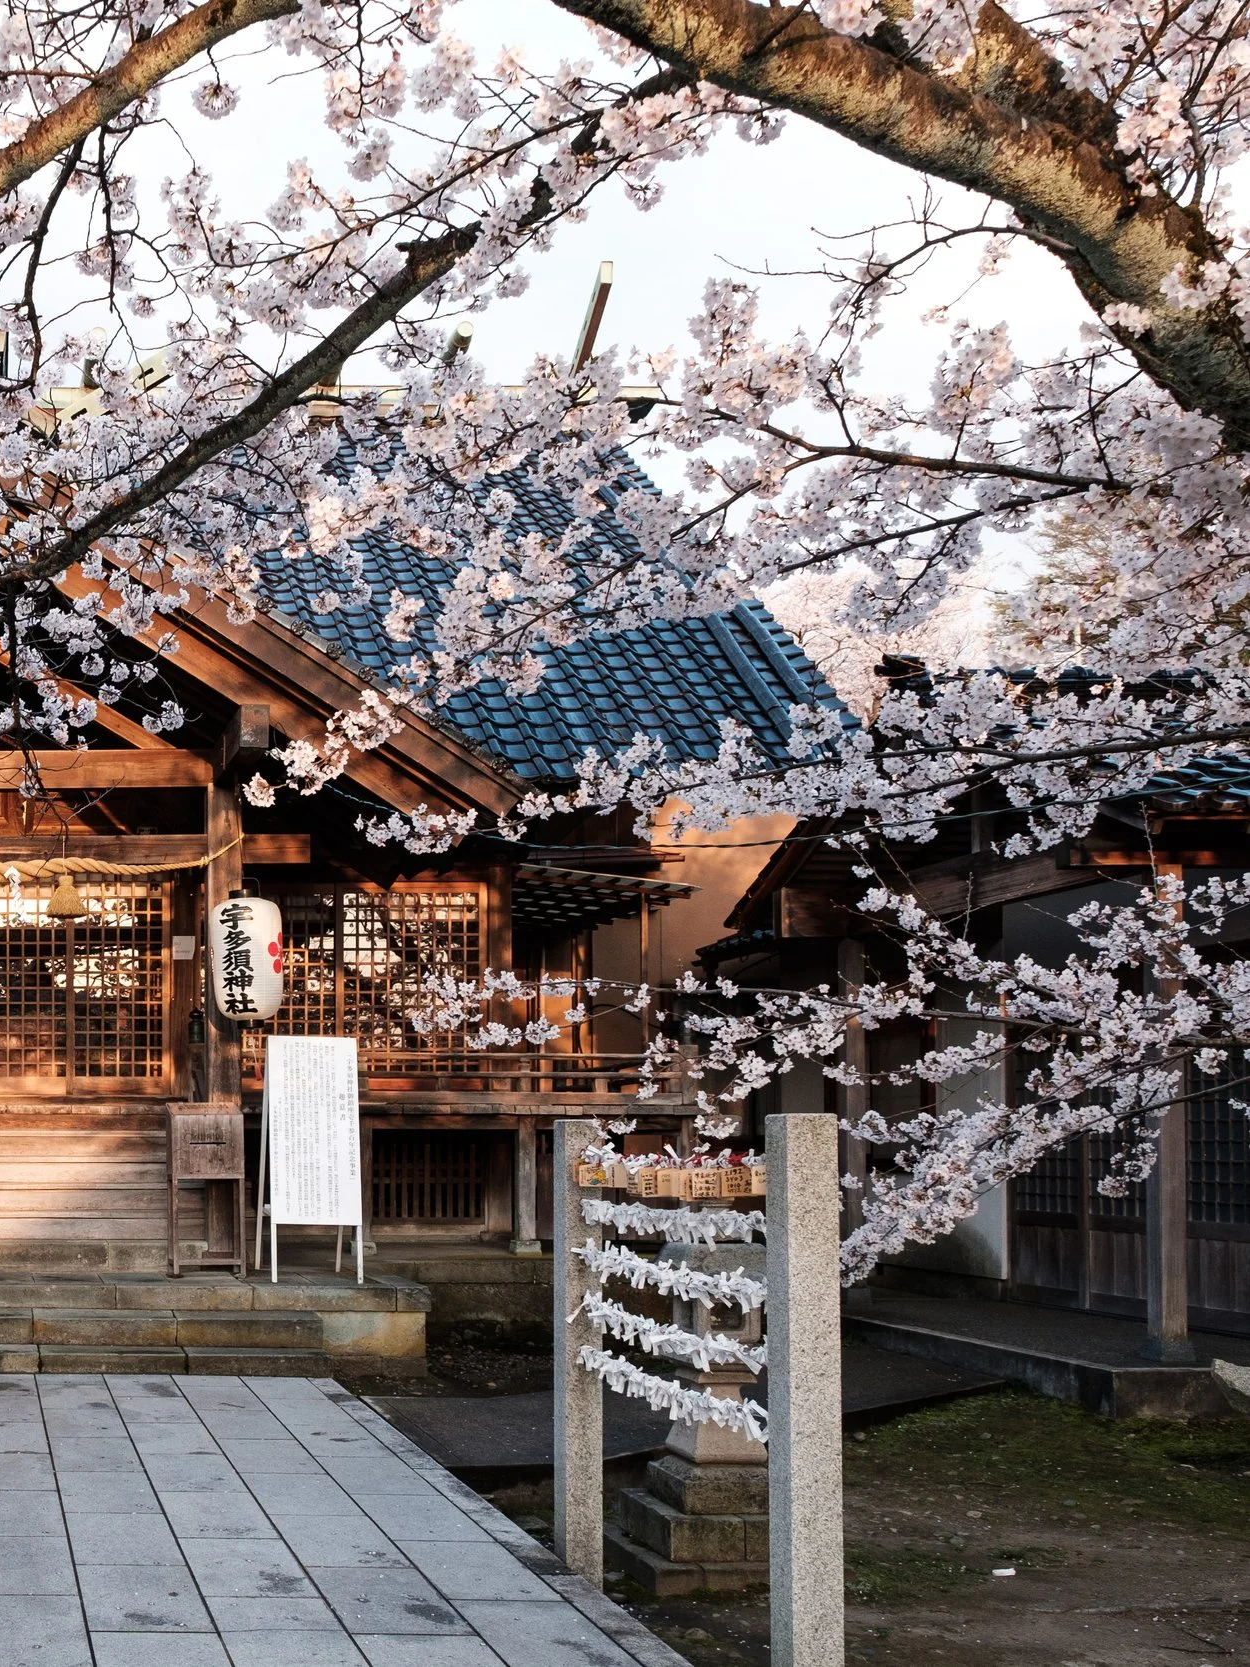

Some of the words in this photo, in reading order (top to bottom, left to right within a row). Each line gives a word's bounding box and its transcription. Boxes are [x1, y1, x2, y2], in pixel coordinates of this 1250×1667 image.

[219, 903, 258, 1014] 宇多須神社
